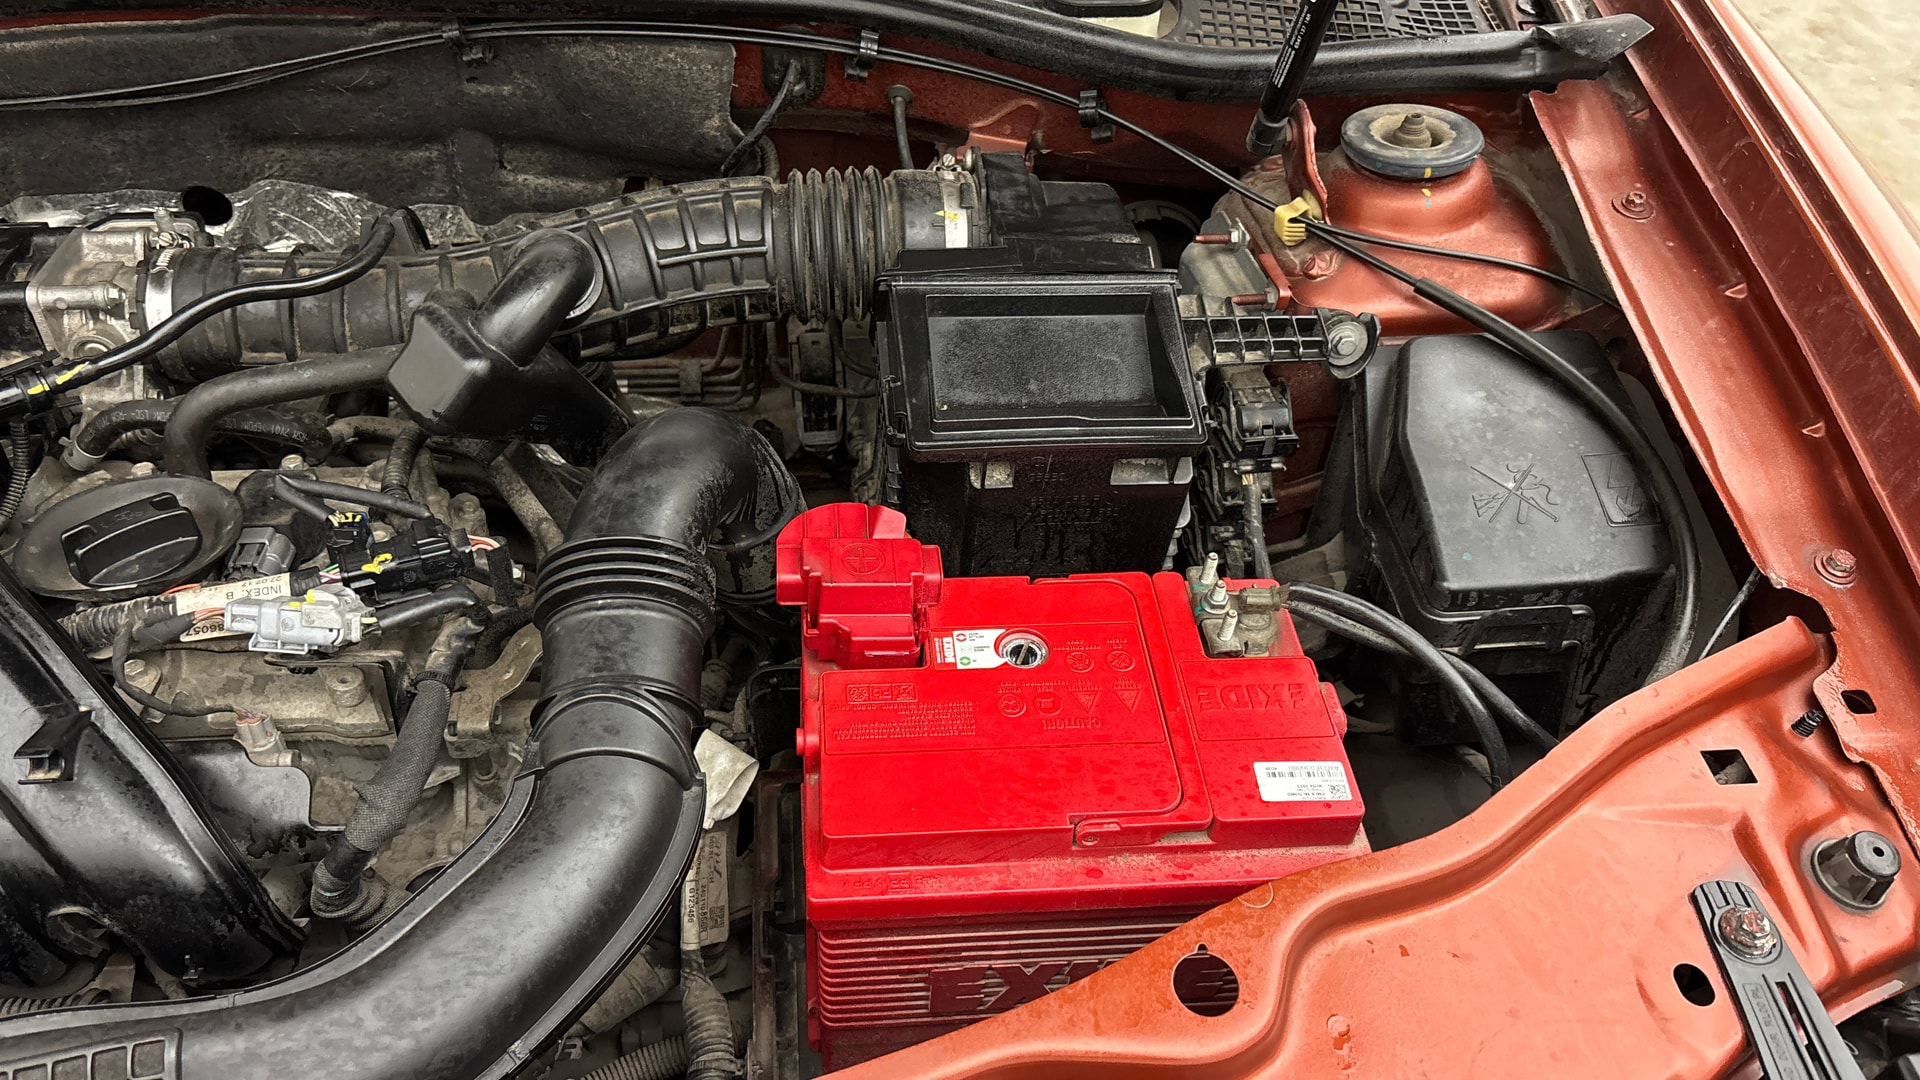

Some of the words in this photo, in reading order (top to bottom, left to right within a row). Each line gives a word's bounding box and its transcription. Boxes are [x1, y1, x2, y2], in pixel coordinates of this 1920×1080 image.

[225, 591, 235, 600] B
[241, 584, 282, 598] INDEX:
[1198, 684, 1309, 711] EXIDE
